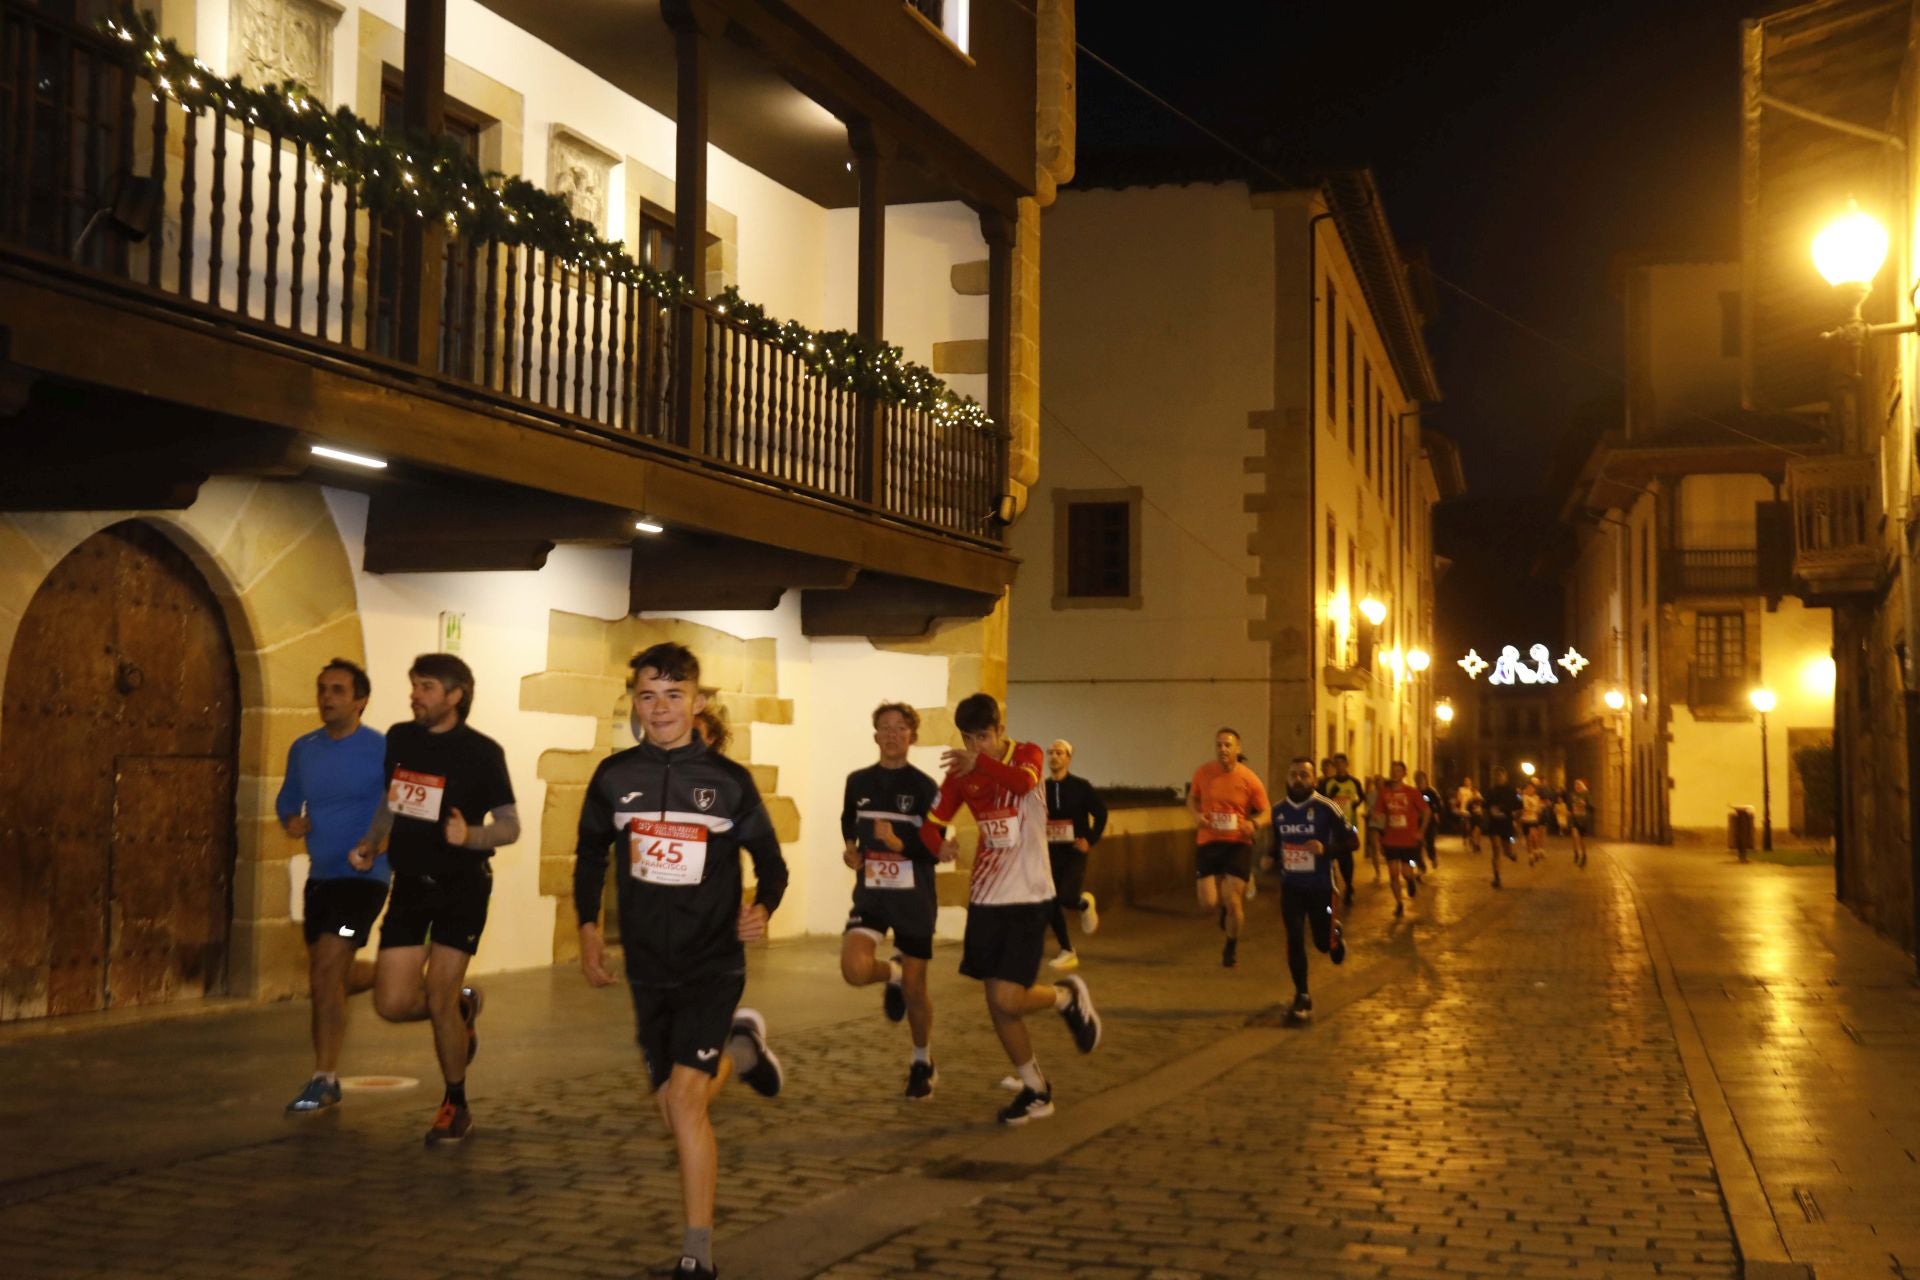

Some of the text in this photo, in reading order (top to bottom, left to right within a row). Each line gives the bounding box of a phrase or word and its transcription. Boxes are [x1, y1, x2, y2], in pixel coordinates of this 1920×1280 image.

[404, 784, 427, 802] 79
[984, 820, 1009, 835] 125
[646, 840, 684, 864] 45
[641, 859, 688, 871] FRANCISCO
[879, 862, 899, 876] 20
